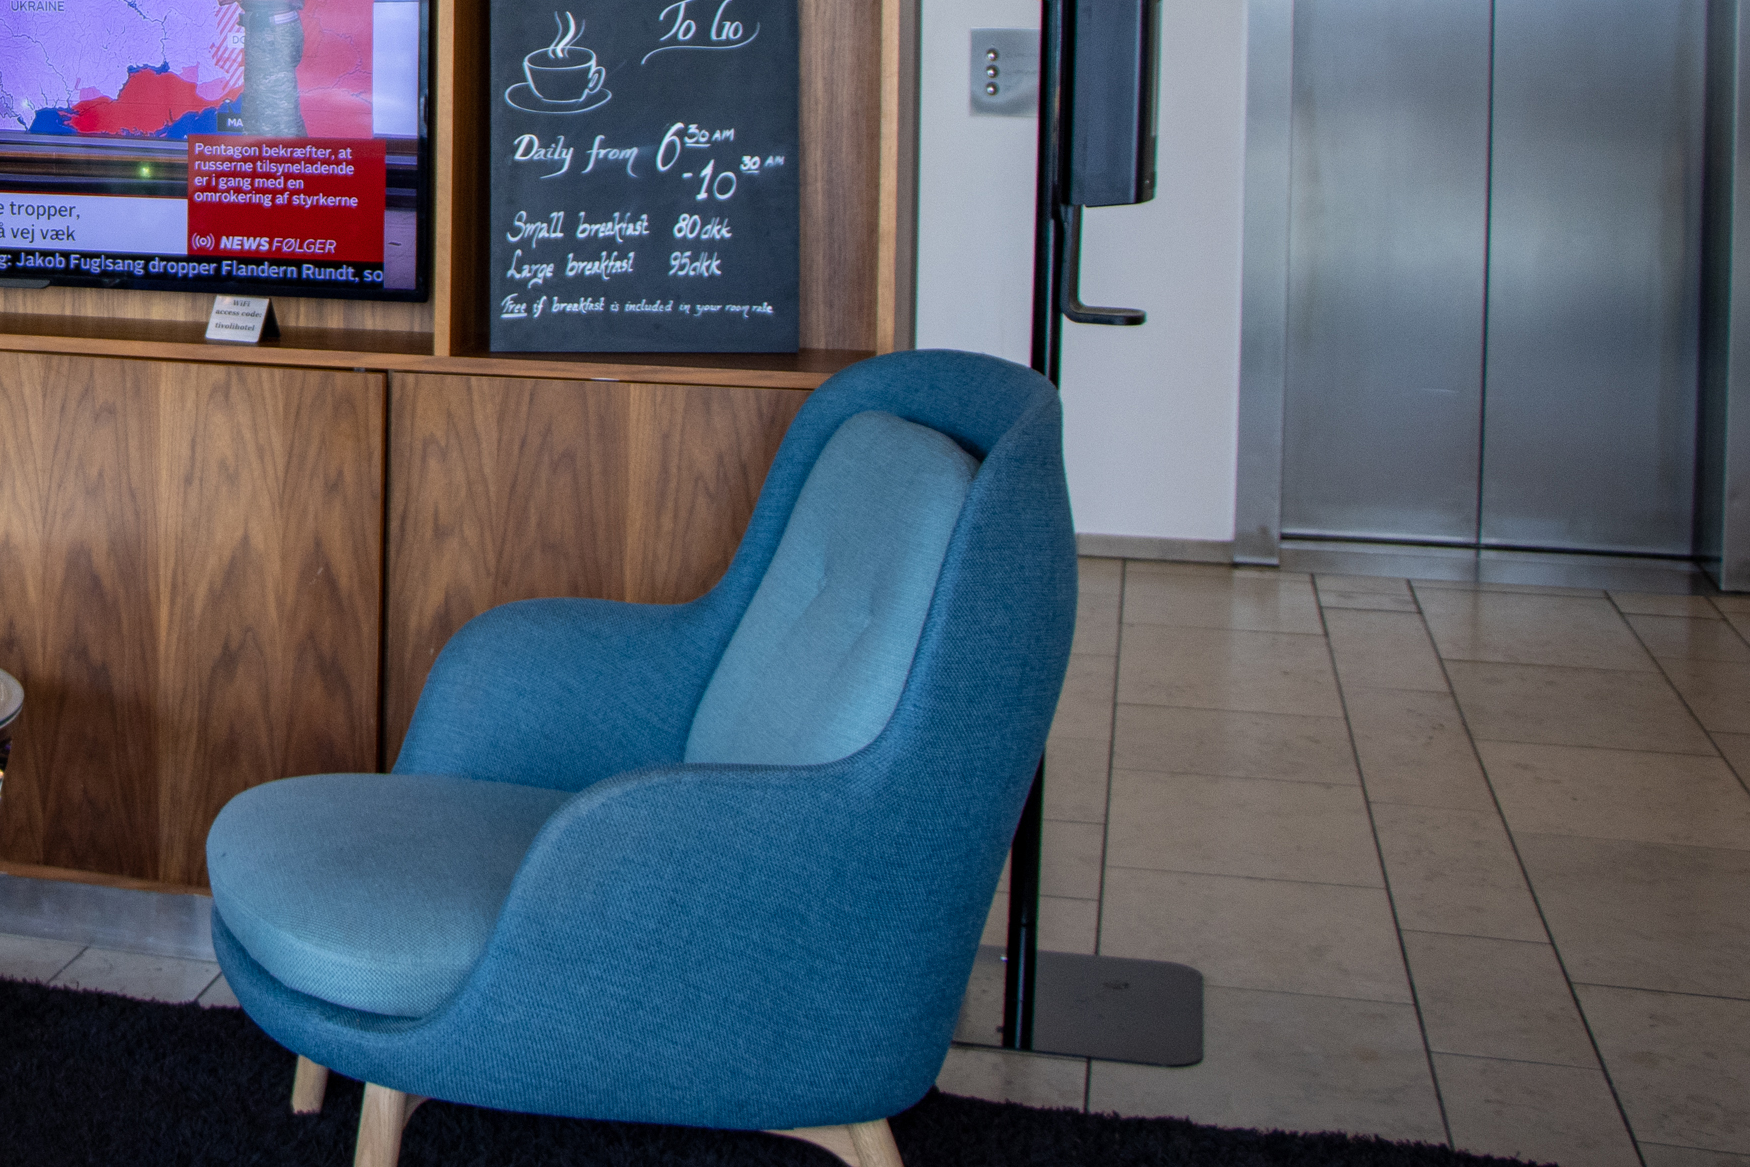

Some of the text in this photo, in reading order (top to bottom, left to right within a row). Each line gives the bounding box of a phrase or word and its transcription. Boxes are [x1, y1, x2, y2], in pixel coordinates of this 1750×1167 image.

[10, 0, 65, 12] UKRAINE
[194, 142, 353, 161] Pentagon bekræfter, at
[513, 133, 574, 179] Daily
[581, 135, 639, 178] from
[194, 160, 355, 176] russerne tilsyneladende
[194, 174, 305, 190] er i gang med en
[194, 190, 359, 209] omrokering af styrkerne
[9, 201, 81, 220] tropper,
[10, 223, 35, 243] vej
[40, 225, 76, 242] væk
[506, 211, 565, 249] Small
[576, 211, 650, 243] breakfast
[220, 235, 337, 254] NEWS FØLGER
[15, 251, 65, 268] Jakob
[69, 252, 145, 275] Fuglsang
[148, 257, 217, 278] dropper
[221, 260, 298, 279] Flandern
[302, 263, 360, 283] Rundt,
[506, 249, 555, 289] Large
[565, 251, 635, 281] breakfast
[501, 293, 774, 319] Free if breakfast is included in your room rate
[214, 322, 256, 331] tivolihotel
